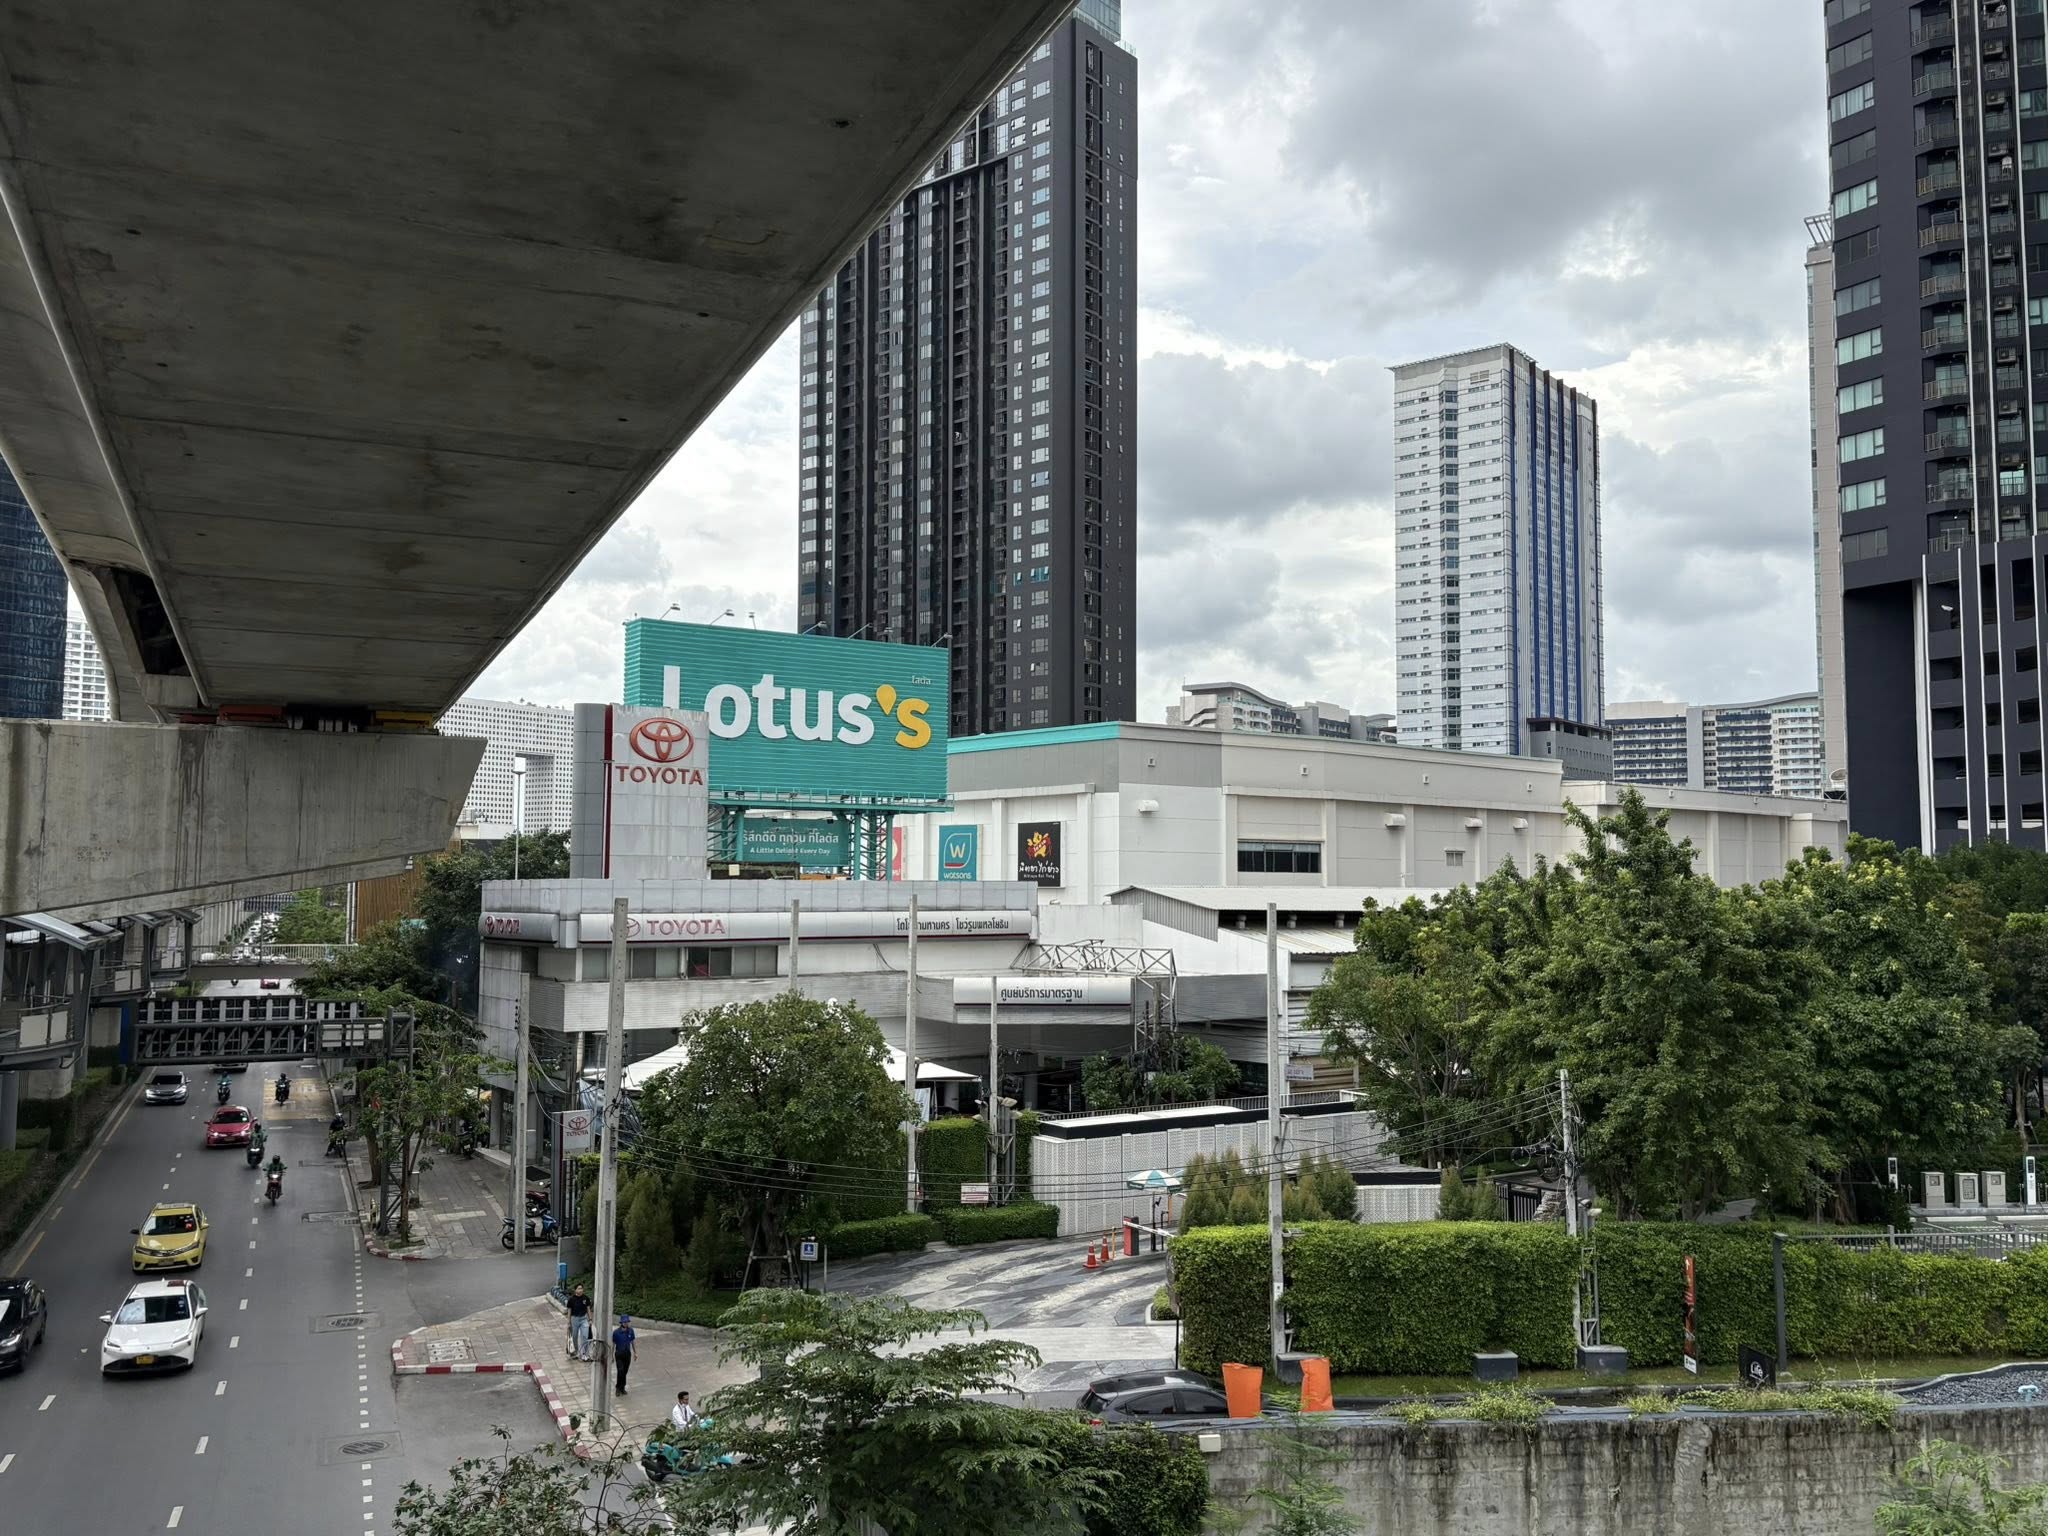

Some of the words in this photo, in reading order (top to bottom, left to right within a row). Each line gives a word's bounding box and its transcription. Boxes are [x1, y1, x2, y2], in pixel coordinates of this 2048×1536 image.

[663, 665, 932, 749] Lotus's
[614, 764, 704, 786] TOYOTA
[800, 848, 817, 856] Every
[818, 848, 831, 856] Day
[943, 871, 972, 880] watsons
[646, 919, 726, 936] TOYOTA
[1000, 985, 1083, 1002] ศูนย์บริการมาตรฐาน
[566, 1129, 589, 1137] TOYOTA
